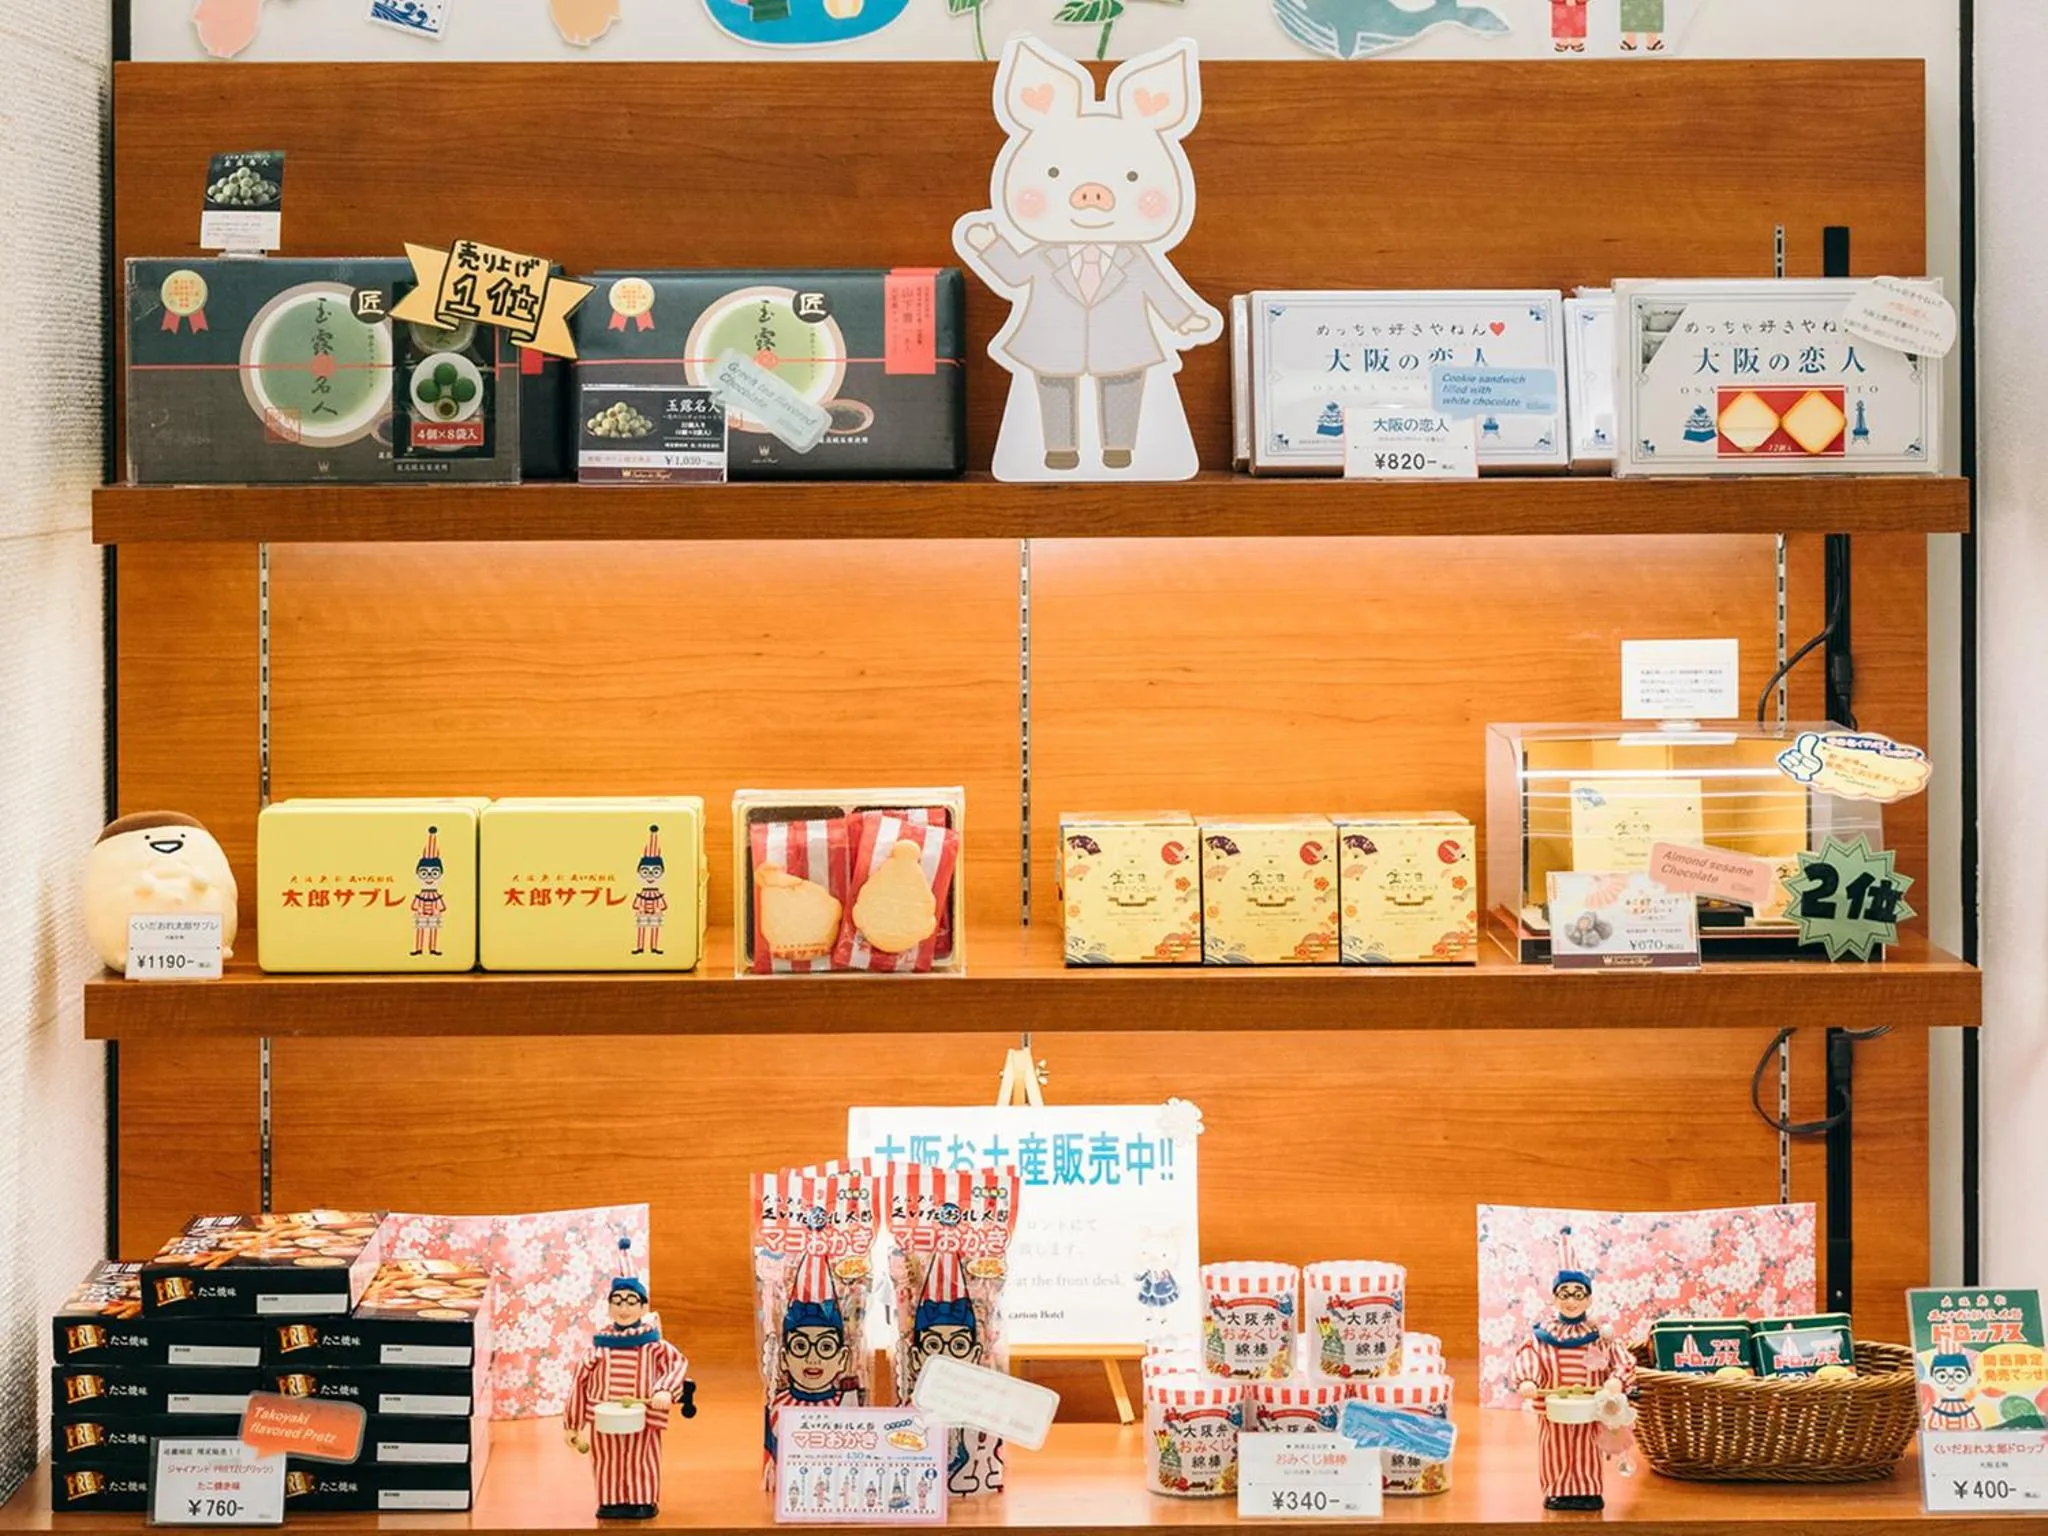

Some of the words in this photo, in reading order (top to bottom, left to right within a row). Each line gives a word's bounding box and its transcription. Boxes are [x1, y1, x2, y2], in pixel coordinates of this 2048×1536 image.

[457, 242, 540, 277] 売り上げ
[359, 291, 384, 315] 匠
[444, 273, 539, 323] 1位
[799, 292, 826, 316] 匠
[1316, 323, 1487, 337] めっちゃ好きやねん
[1684, 319, 1849, 336] めっちゃ好きやね
[1693, 345, 1867, 375] 大阪の恋人
[1442, 373, 1476, 384] Cookie
[1478, 373, 1527, 384] sandwich
[1470, 384, 1492, 394] with
[1442, 397, 1470, 406] white
[1472, 397, 1521, 408] chocolate
[1373, 418, 1450, 433] 大阪の恋人
[1662, 850, 1708, 868] Almond
[1708, 861, 1755, 877] sesame
[1660, 864, 1720, 884] Chocolate
[281, 888, 406, 908] 太郎サブレ
[503, 886, 628, 907] 太郎サブレ
[1801, 862, 1904, 924] 2位
[760, 1227, 874, 1256] マヨおかき
[890, 1225, 1010, 1256] マヨおかき
[1226, 1311, 1277, 1326] 大阪弁
[1347, 1311, 1393, 1325] 大阪弁
[1222, 1327, 1279, 1341] おみくじ
[1343, 1325, 1394, 1341] おみくじ
[1931, 1322, 2028, 1343] ドロップス
[1674, 1351, 1742, 1367] ドロップス
[1773, 1352, 1842, 1368] ドロップス
[254, 1406, 312, 1425] Takoyaki
[250, 1421, 302, 1439] flavored
[1183, 1423, 1229, 1438] 大阪弁
[792, 1430, 878, 1449] マヨおかき
[1178, 1438, 1231, 1454] おみくじ
[1274, 1453, 1348, 1466] おみくじ綿棒
